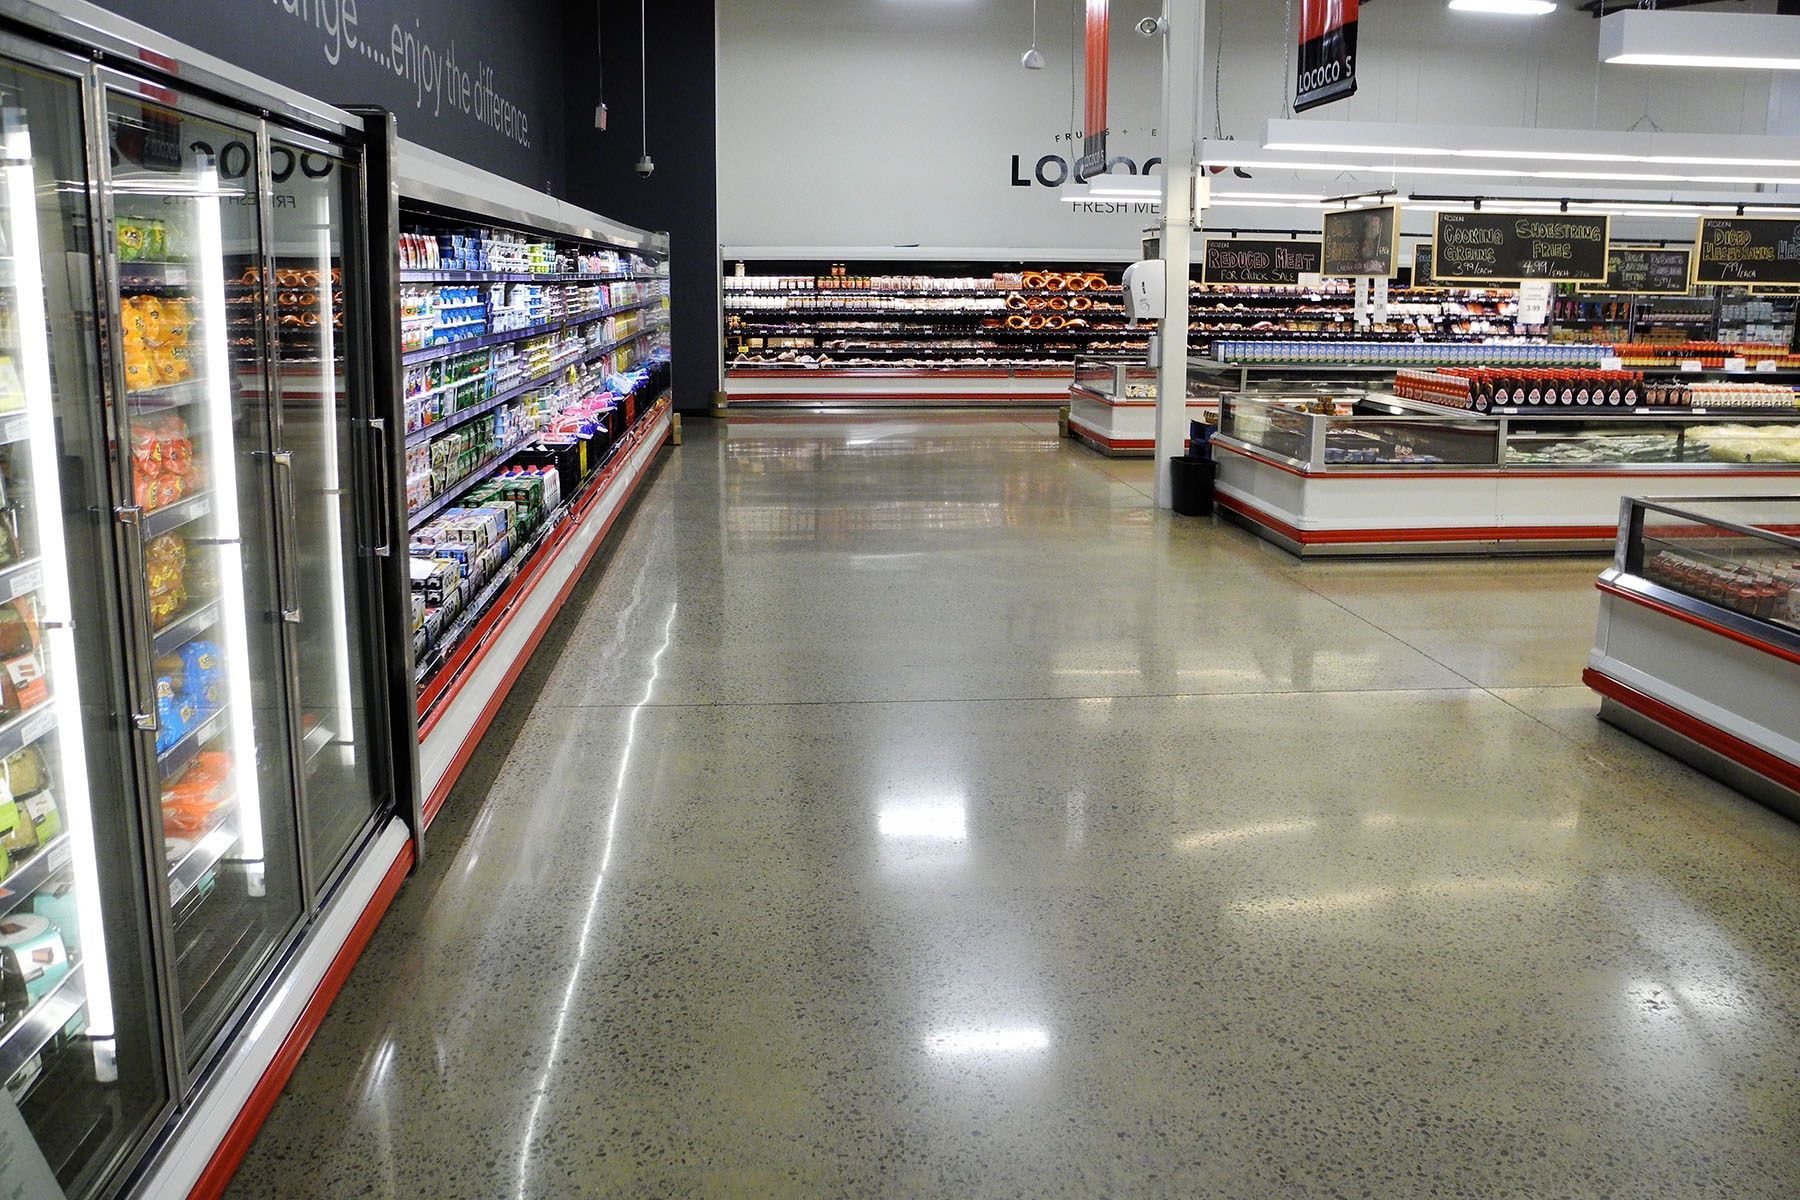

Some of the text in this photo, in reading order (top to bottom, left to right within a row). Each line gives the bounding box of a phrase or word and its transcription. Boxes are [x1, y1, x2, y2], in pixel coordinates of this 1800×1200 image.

[446, 39, 471, 114] the
[1072, 201, 1128, 213] FRESH
[1441, 214, 1465, 222] FROZEN
[1444, 224, 1503, 246] COOKING
[1515, 218, 1600, 242] SHOESTRING
[1714, 228, 1752, 247] DICED
[1208, 248, 1270, 269] REDUCED
[1275, 247, 1314, 270] MEAT
[1444, 245, 1497, 264] GREENS
[1532, 240, 1573, 259] FRIES
[1220, 268, 1296, 282] FOR QUICK SALE
